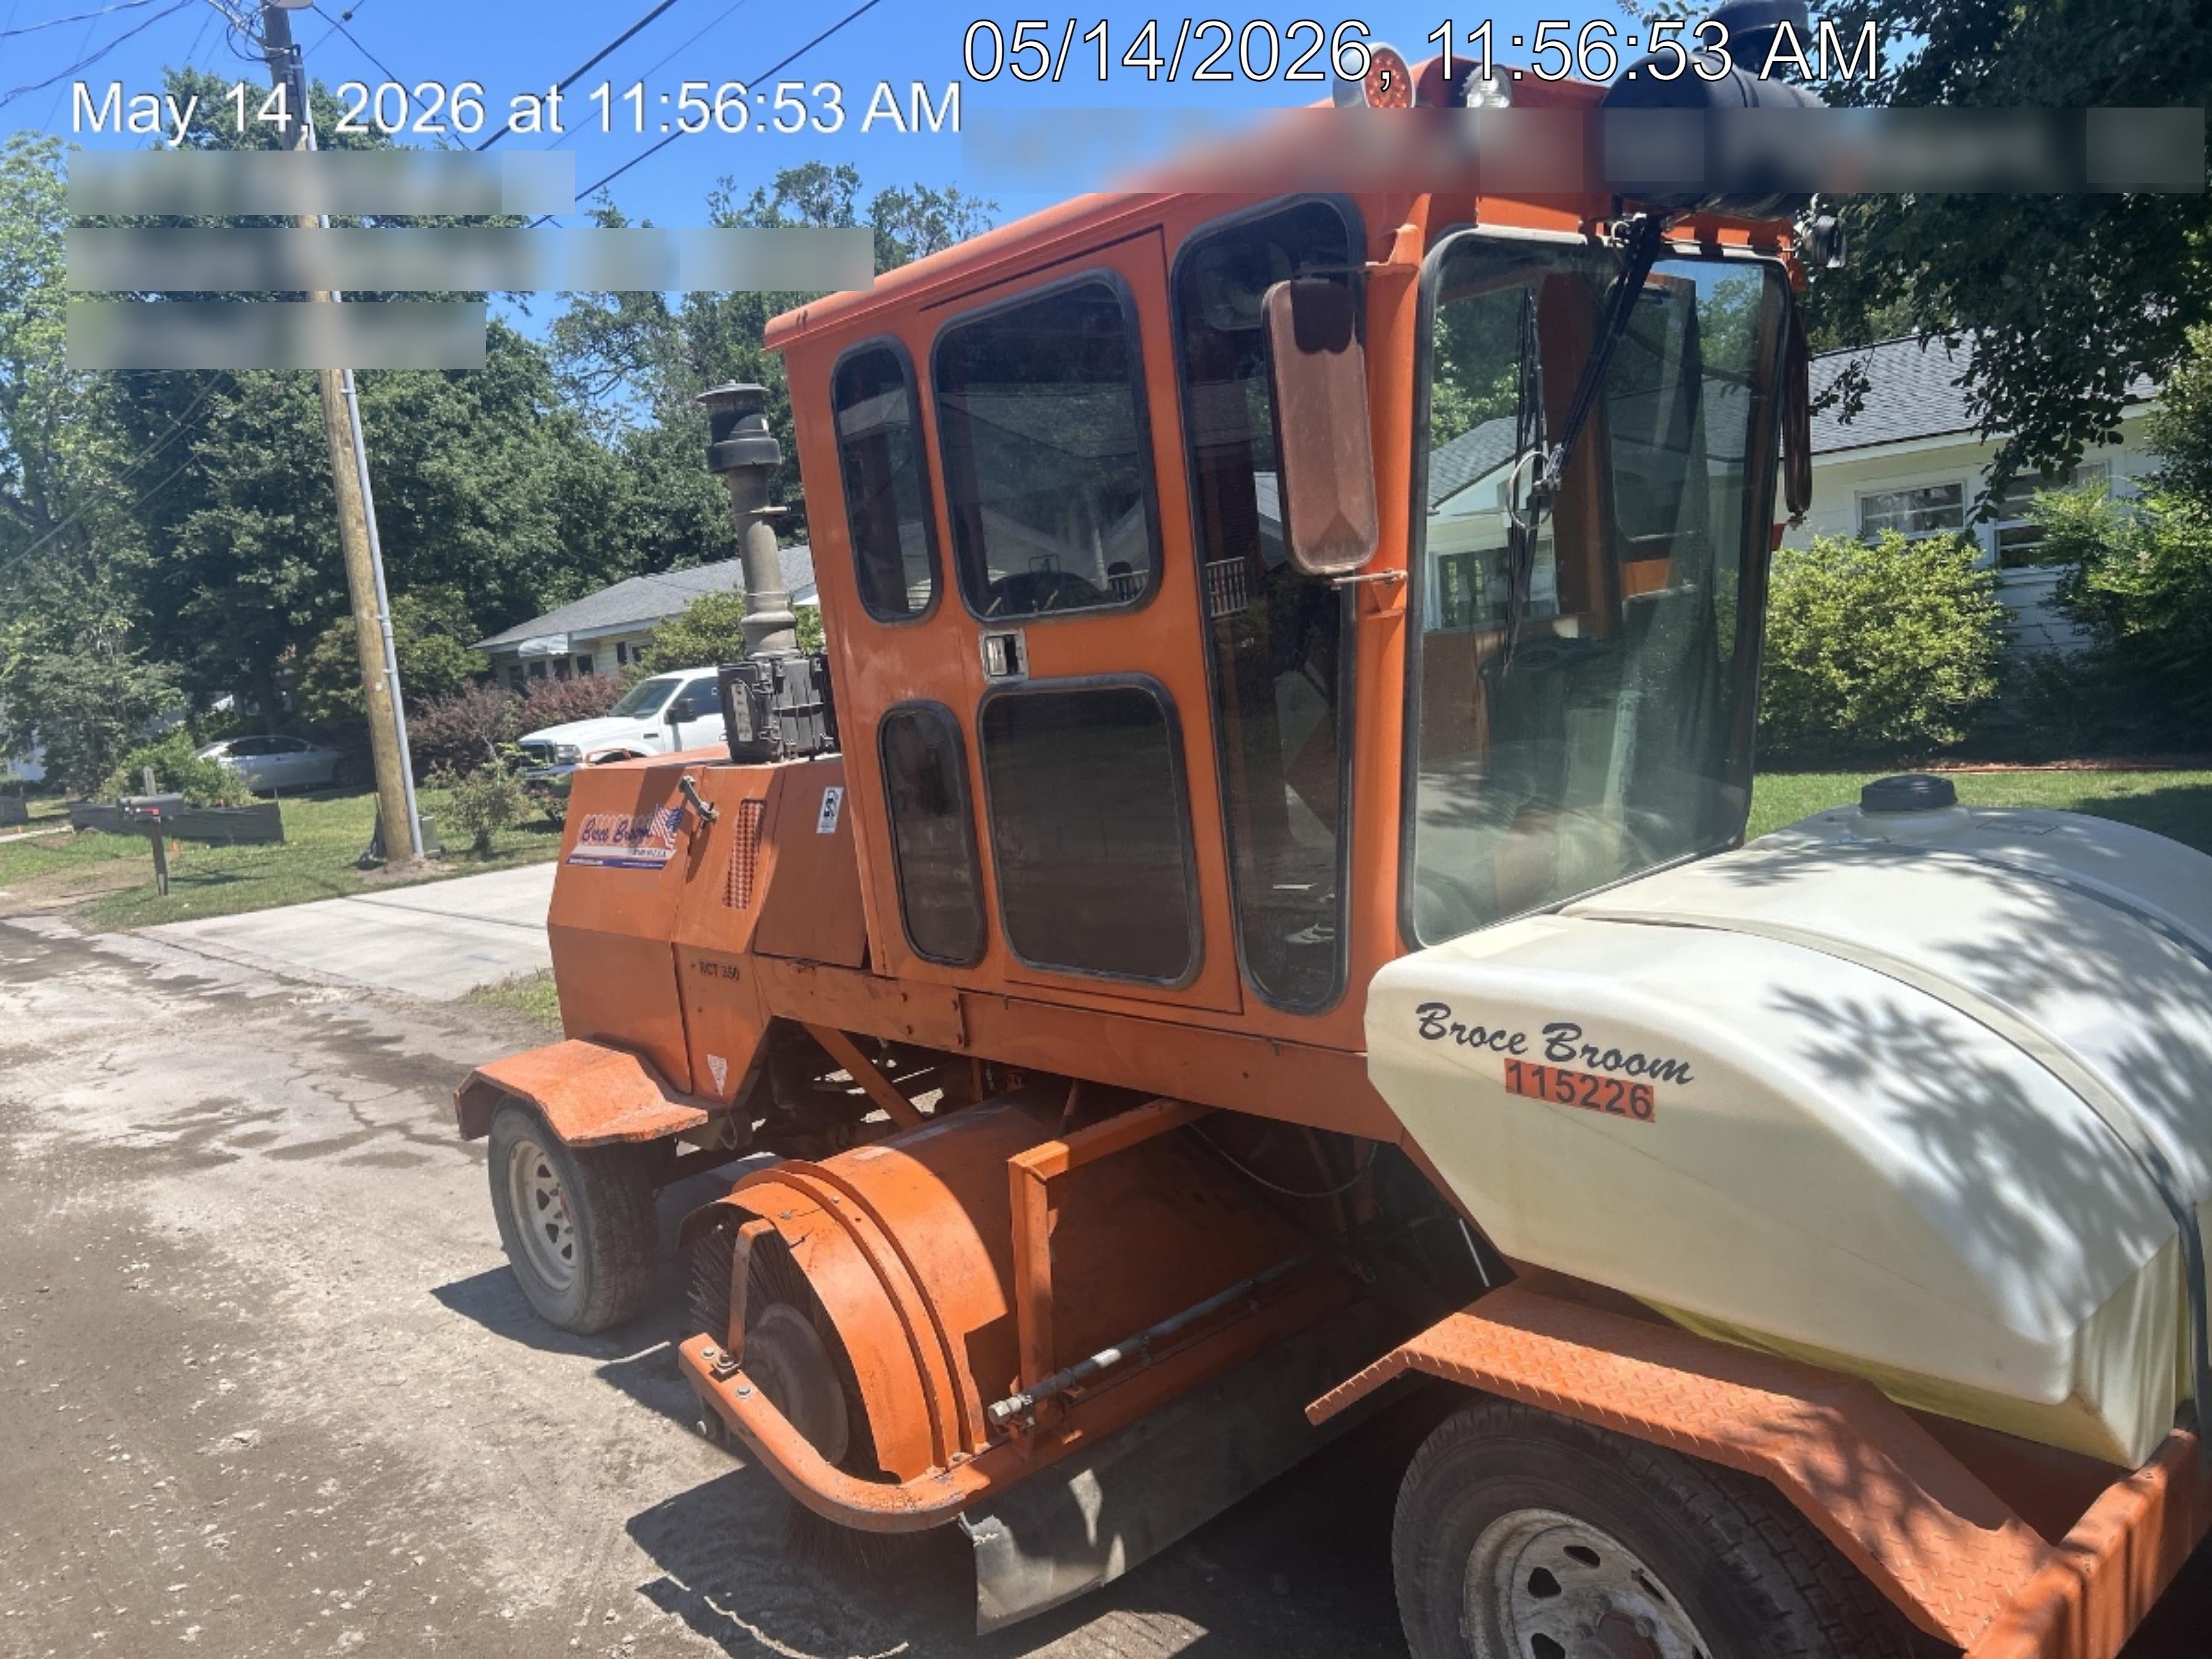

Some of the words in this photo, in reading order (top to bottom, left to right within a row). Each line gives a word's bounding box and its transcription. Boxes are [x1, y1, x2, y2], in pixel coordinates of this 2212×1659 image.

[1416, 1002, 1529, 1055] Broce
[1542, 1022, 1695, 1084] Broom
[1507, 1061, 1653, 1120] 115226
